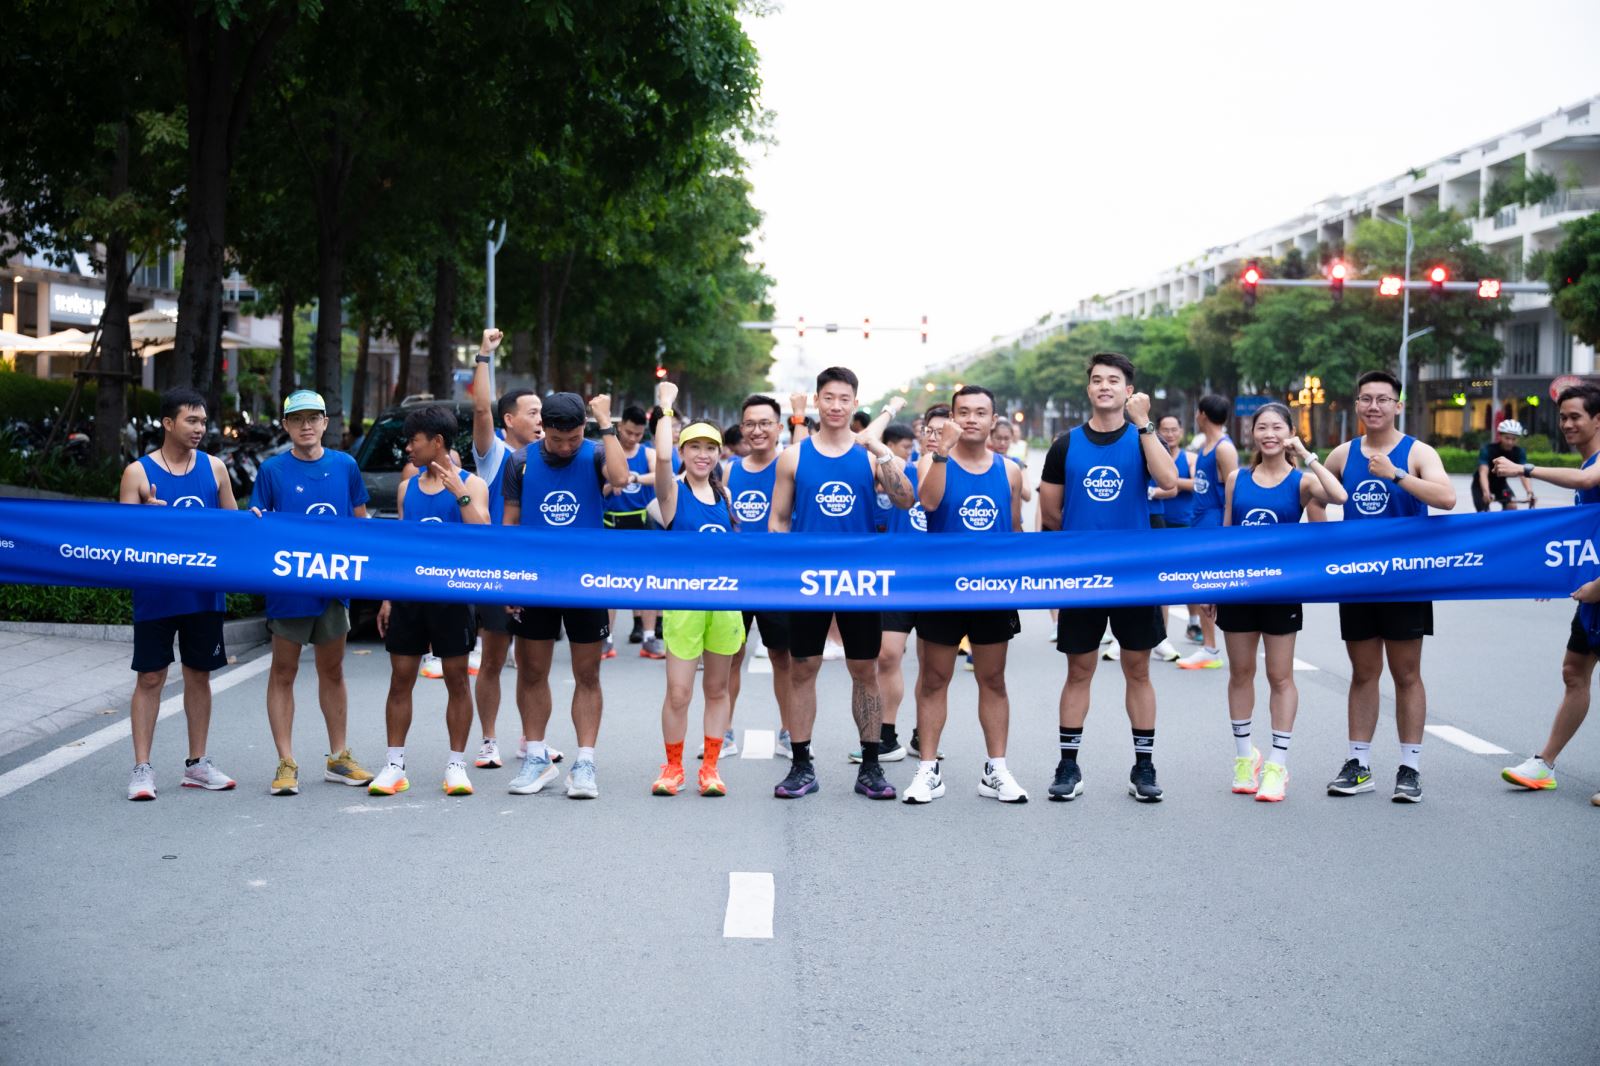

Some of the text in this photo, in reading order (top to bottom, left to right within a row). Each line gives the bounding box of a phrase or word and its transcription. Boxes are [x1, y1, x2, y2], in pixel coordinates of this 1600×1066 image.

[1083, 478, 1124, 490] Galaxy
[815, 494, 856, 506] Galaxy
[1352, 492, 1390, 504] Galaxy
[540, 503, 581, 515] Galaxy
[734, 501, 770, 513] Galaxy
[958, 507, 999, 520] Galaxy
[60, 543, 218, 568] Galaxy RunnerzZz
[1544, 539, 1600, 568] STA
[272, 550, 369, 581] START
[1325, 552, 1484, 576] Galaxy RunnerzZz
[415, 565, 538, 581] Galaxy Watch8 Series
[1158, 567, 1282, 583] Galaxy Watch8 Series
[447, 580, 493, 591] Galaxy AI
[580, 573, 739, 593] Galaxy RunnerzZz
[799, 569, 896, 597] START
[955, 574, 1114, 594] Galaxy RunnerzZz
[1192, 581, 1228, 590] Galaxy
